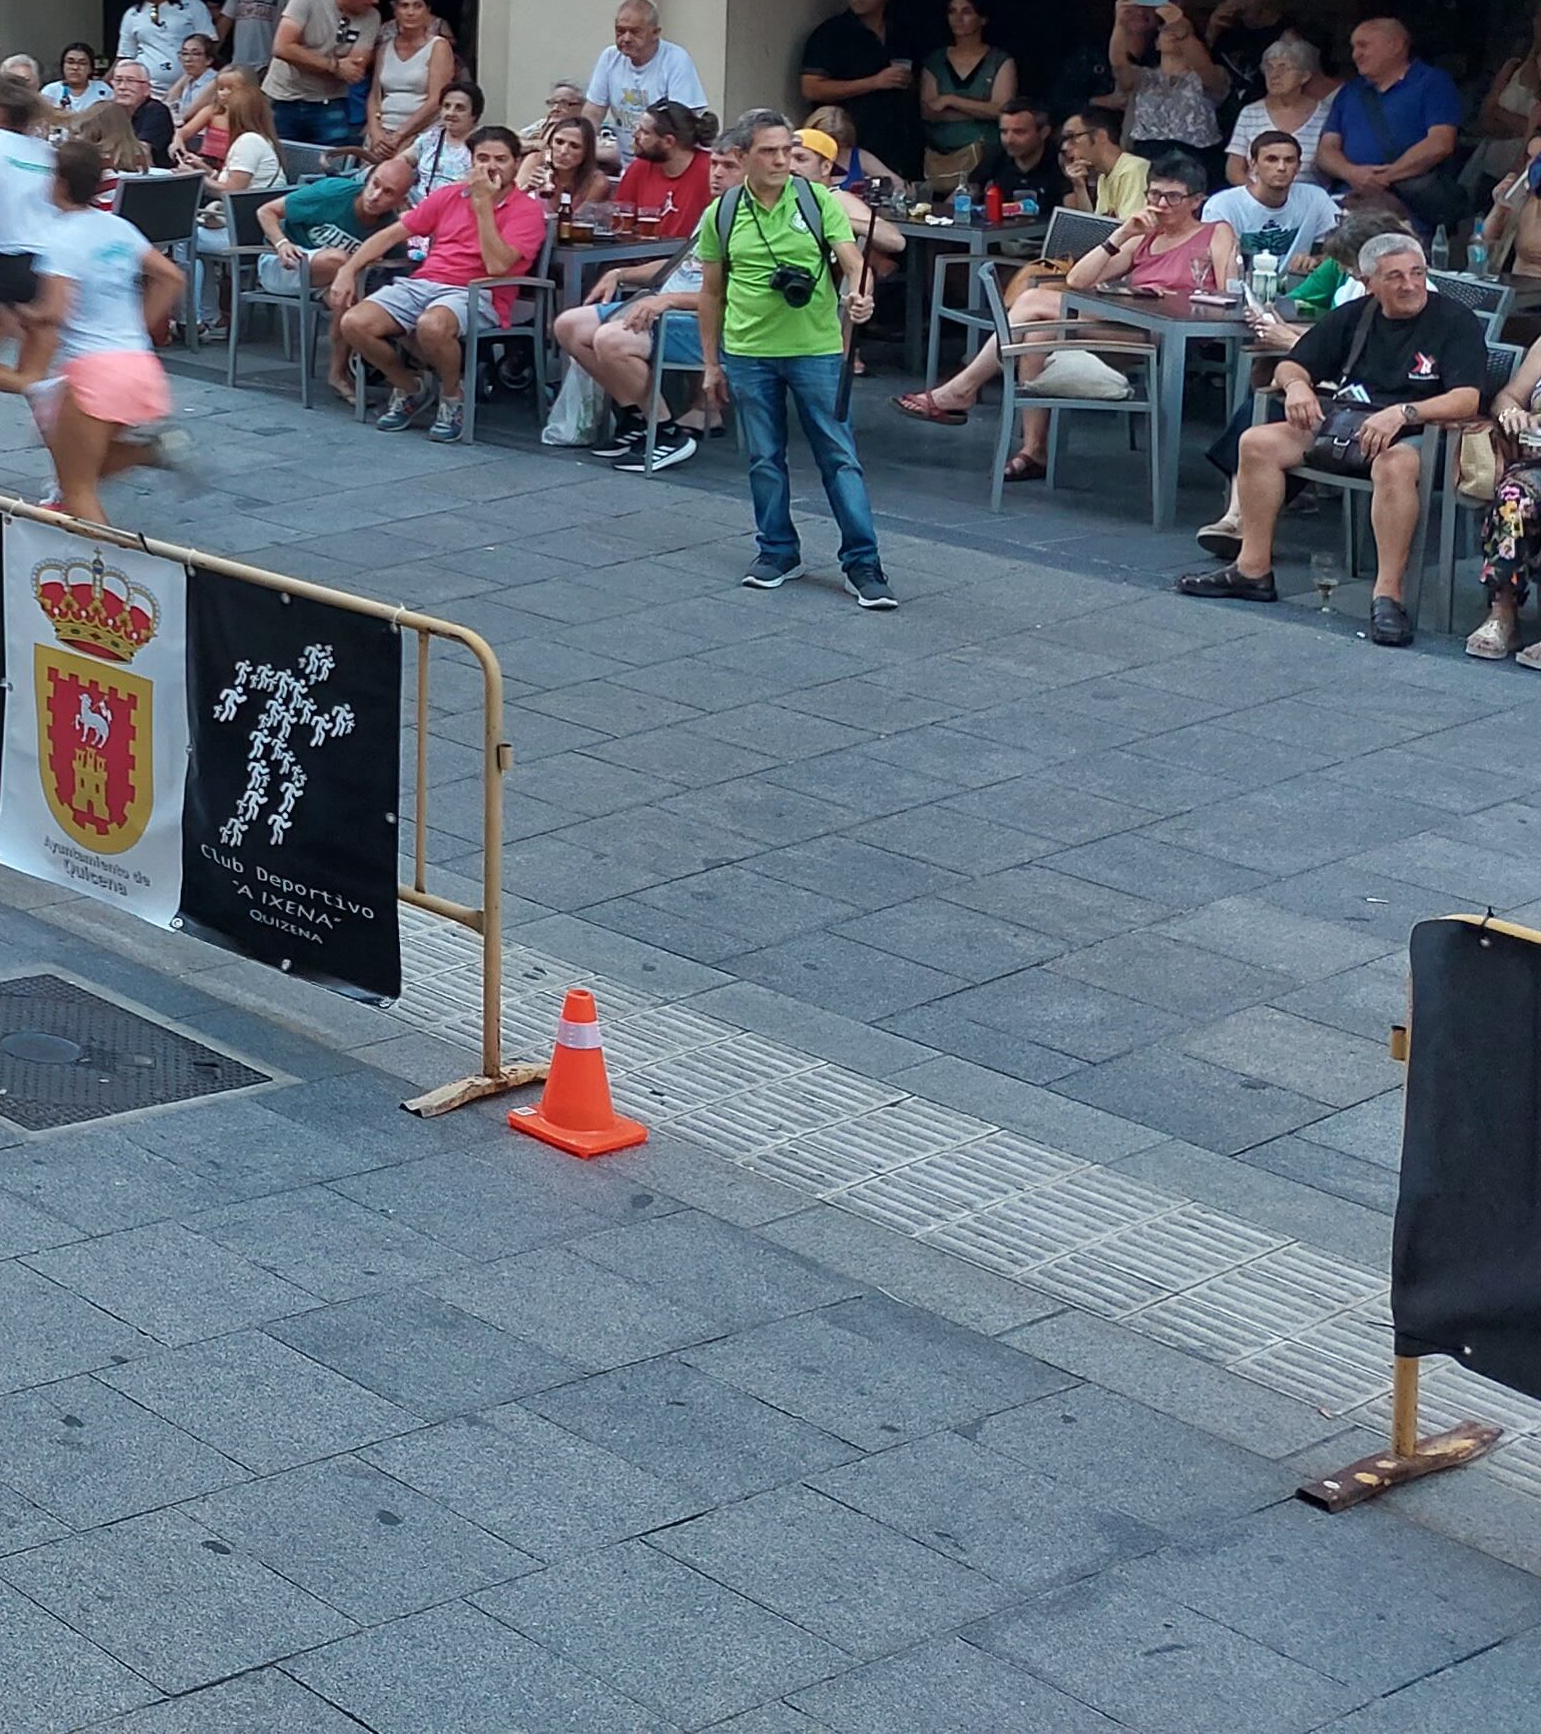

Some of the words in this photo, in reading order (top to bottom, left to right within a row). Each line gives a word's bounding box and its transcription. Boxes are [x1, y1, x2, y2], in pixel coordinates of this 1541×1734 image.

[44, 835, 130, 880] Ayuntamiento
[133, 870, 152, 887] de
[63, 858, 129, 896] Quicena
[200, 843, 245, 874] Club
[255, 865, 375, 920] Deportivo
[249, 908, 324, 945] QUIZENA
